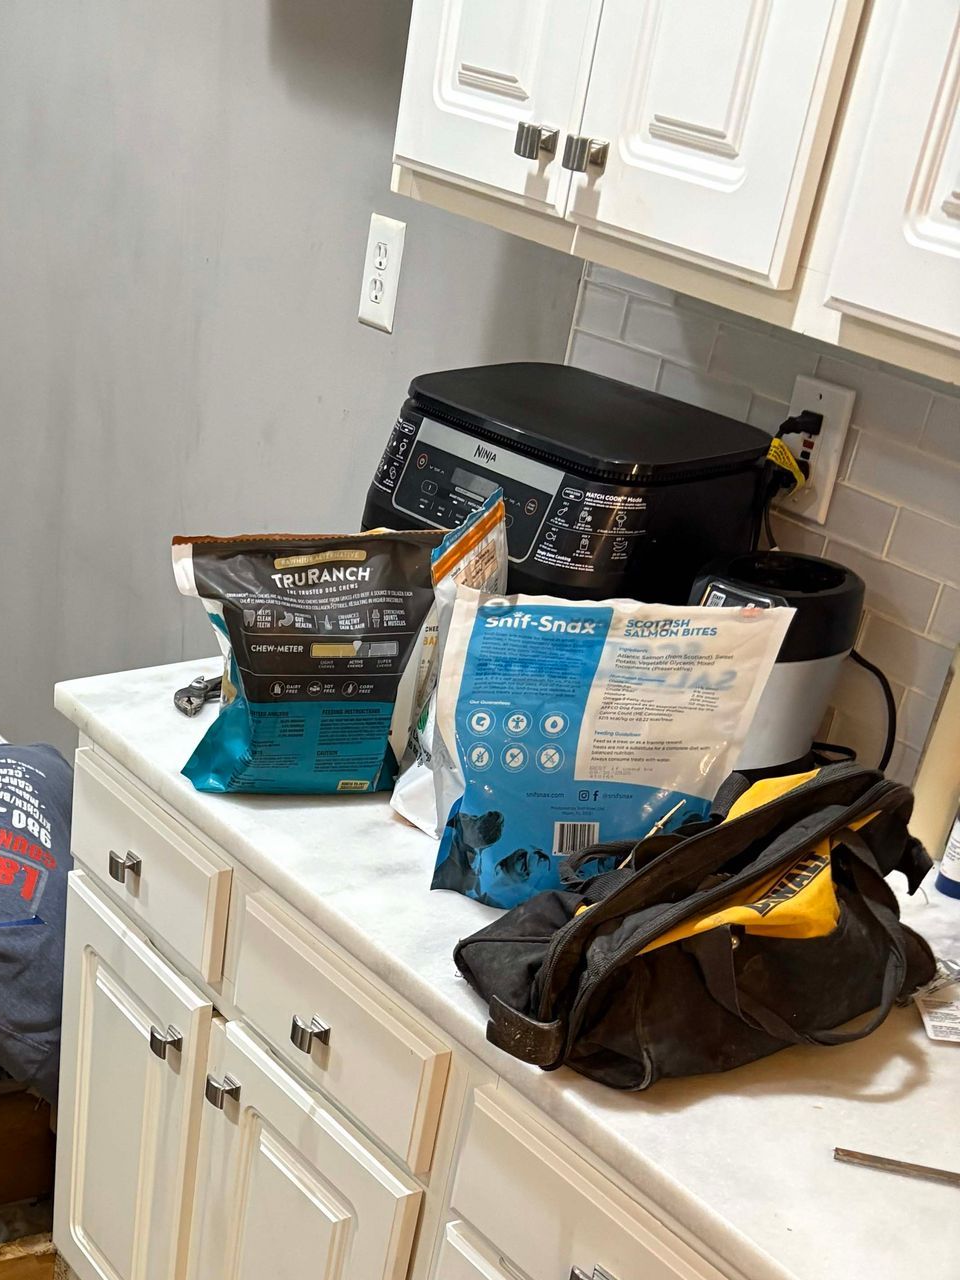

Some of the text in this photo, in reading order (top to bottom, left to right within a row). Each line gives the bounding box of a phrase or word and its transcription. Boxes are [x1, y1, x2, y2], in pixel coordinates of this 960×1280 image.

[324, 586, 337, 594] DOG
[338, 583, 359, 592] CHEWS
[623, 627, 718, 638] SALMON BITES
[250, 644, 304, 653] CHEW-METER
[12, 808, 52, 849] 980
